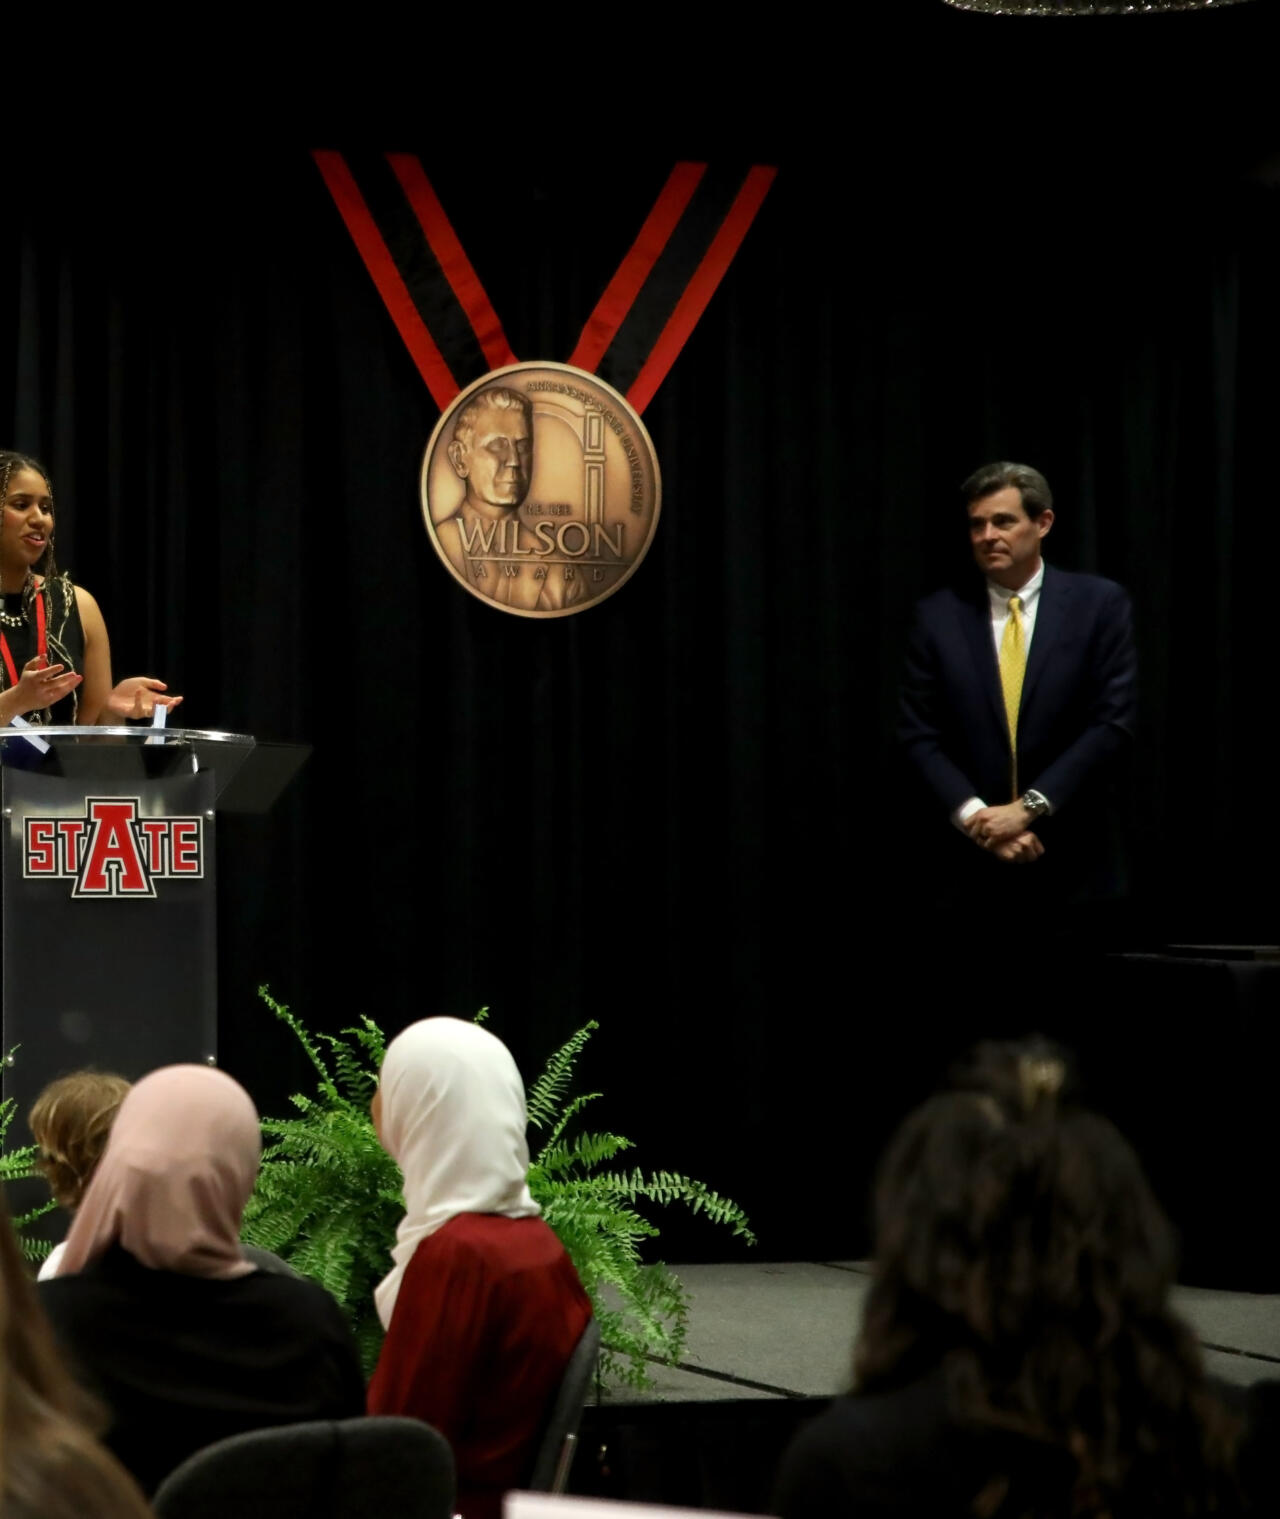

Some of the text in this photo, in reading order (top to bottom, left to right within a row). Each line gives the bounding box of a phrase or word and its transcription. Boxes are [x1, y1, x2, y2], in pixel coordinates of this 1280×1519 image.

[456, 518, 624, 557] WILSON
[475, 565, 604, 581] AWARD
[23, 796, 204, 898] STATE
